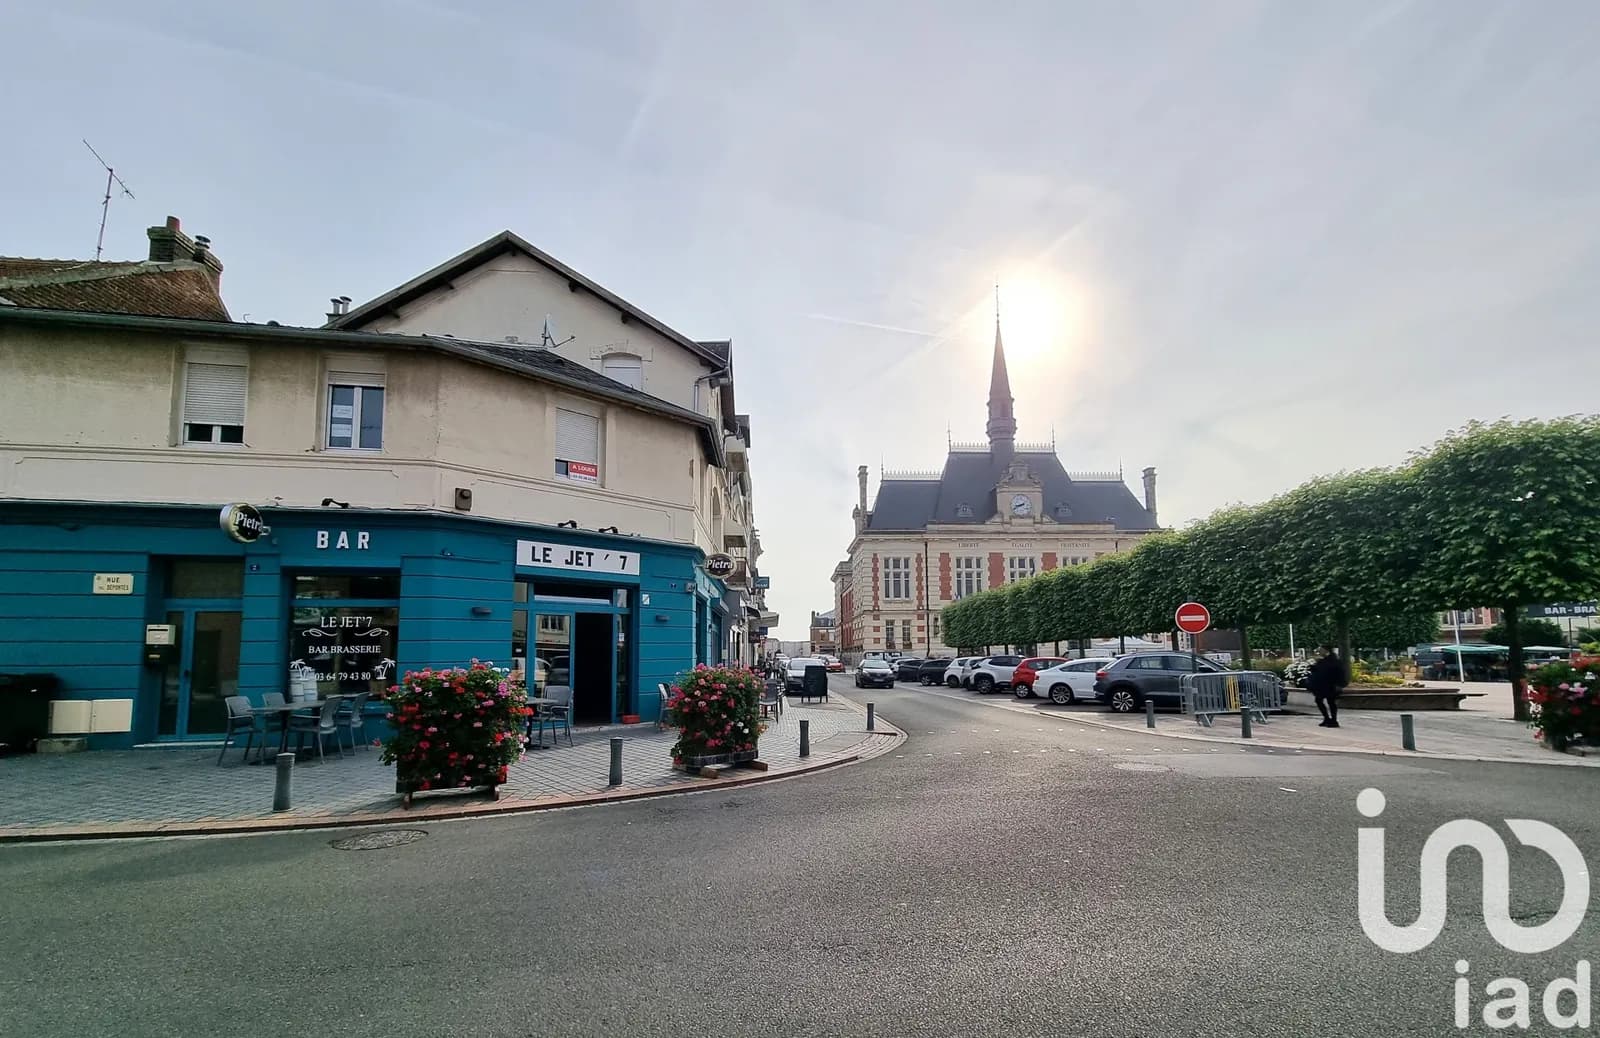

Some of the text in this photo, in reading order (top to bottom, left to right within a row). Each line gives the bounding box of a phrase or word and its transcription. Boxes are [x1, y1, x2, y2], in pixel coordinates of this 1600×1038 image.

[316, 530, 370, 550] BAR
[531, 546, 552, 563] LE
[565, 550, 594, 567] JET
[619, 555, 627, 570] 7
[706, 559, 733, 569] Pietra
[1544, 606, 1567, 615] BAR
[320, 616, 337, 628] LE
[308, 645, 381, 654] BAR BRASSERIE
[314, 672, 371, 681] 03 64 79 43 80
